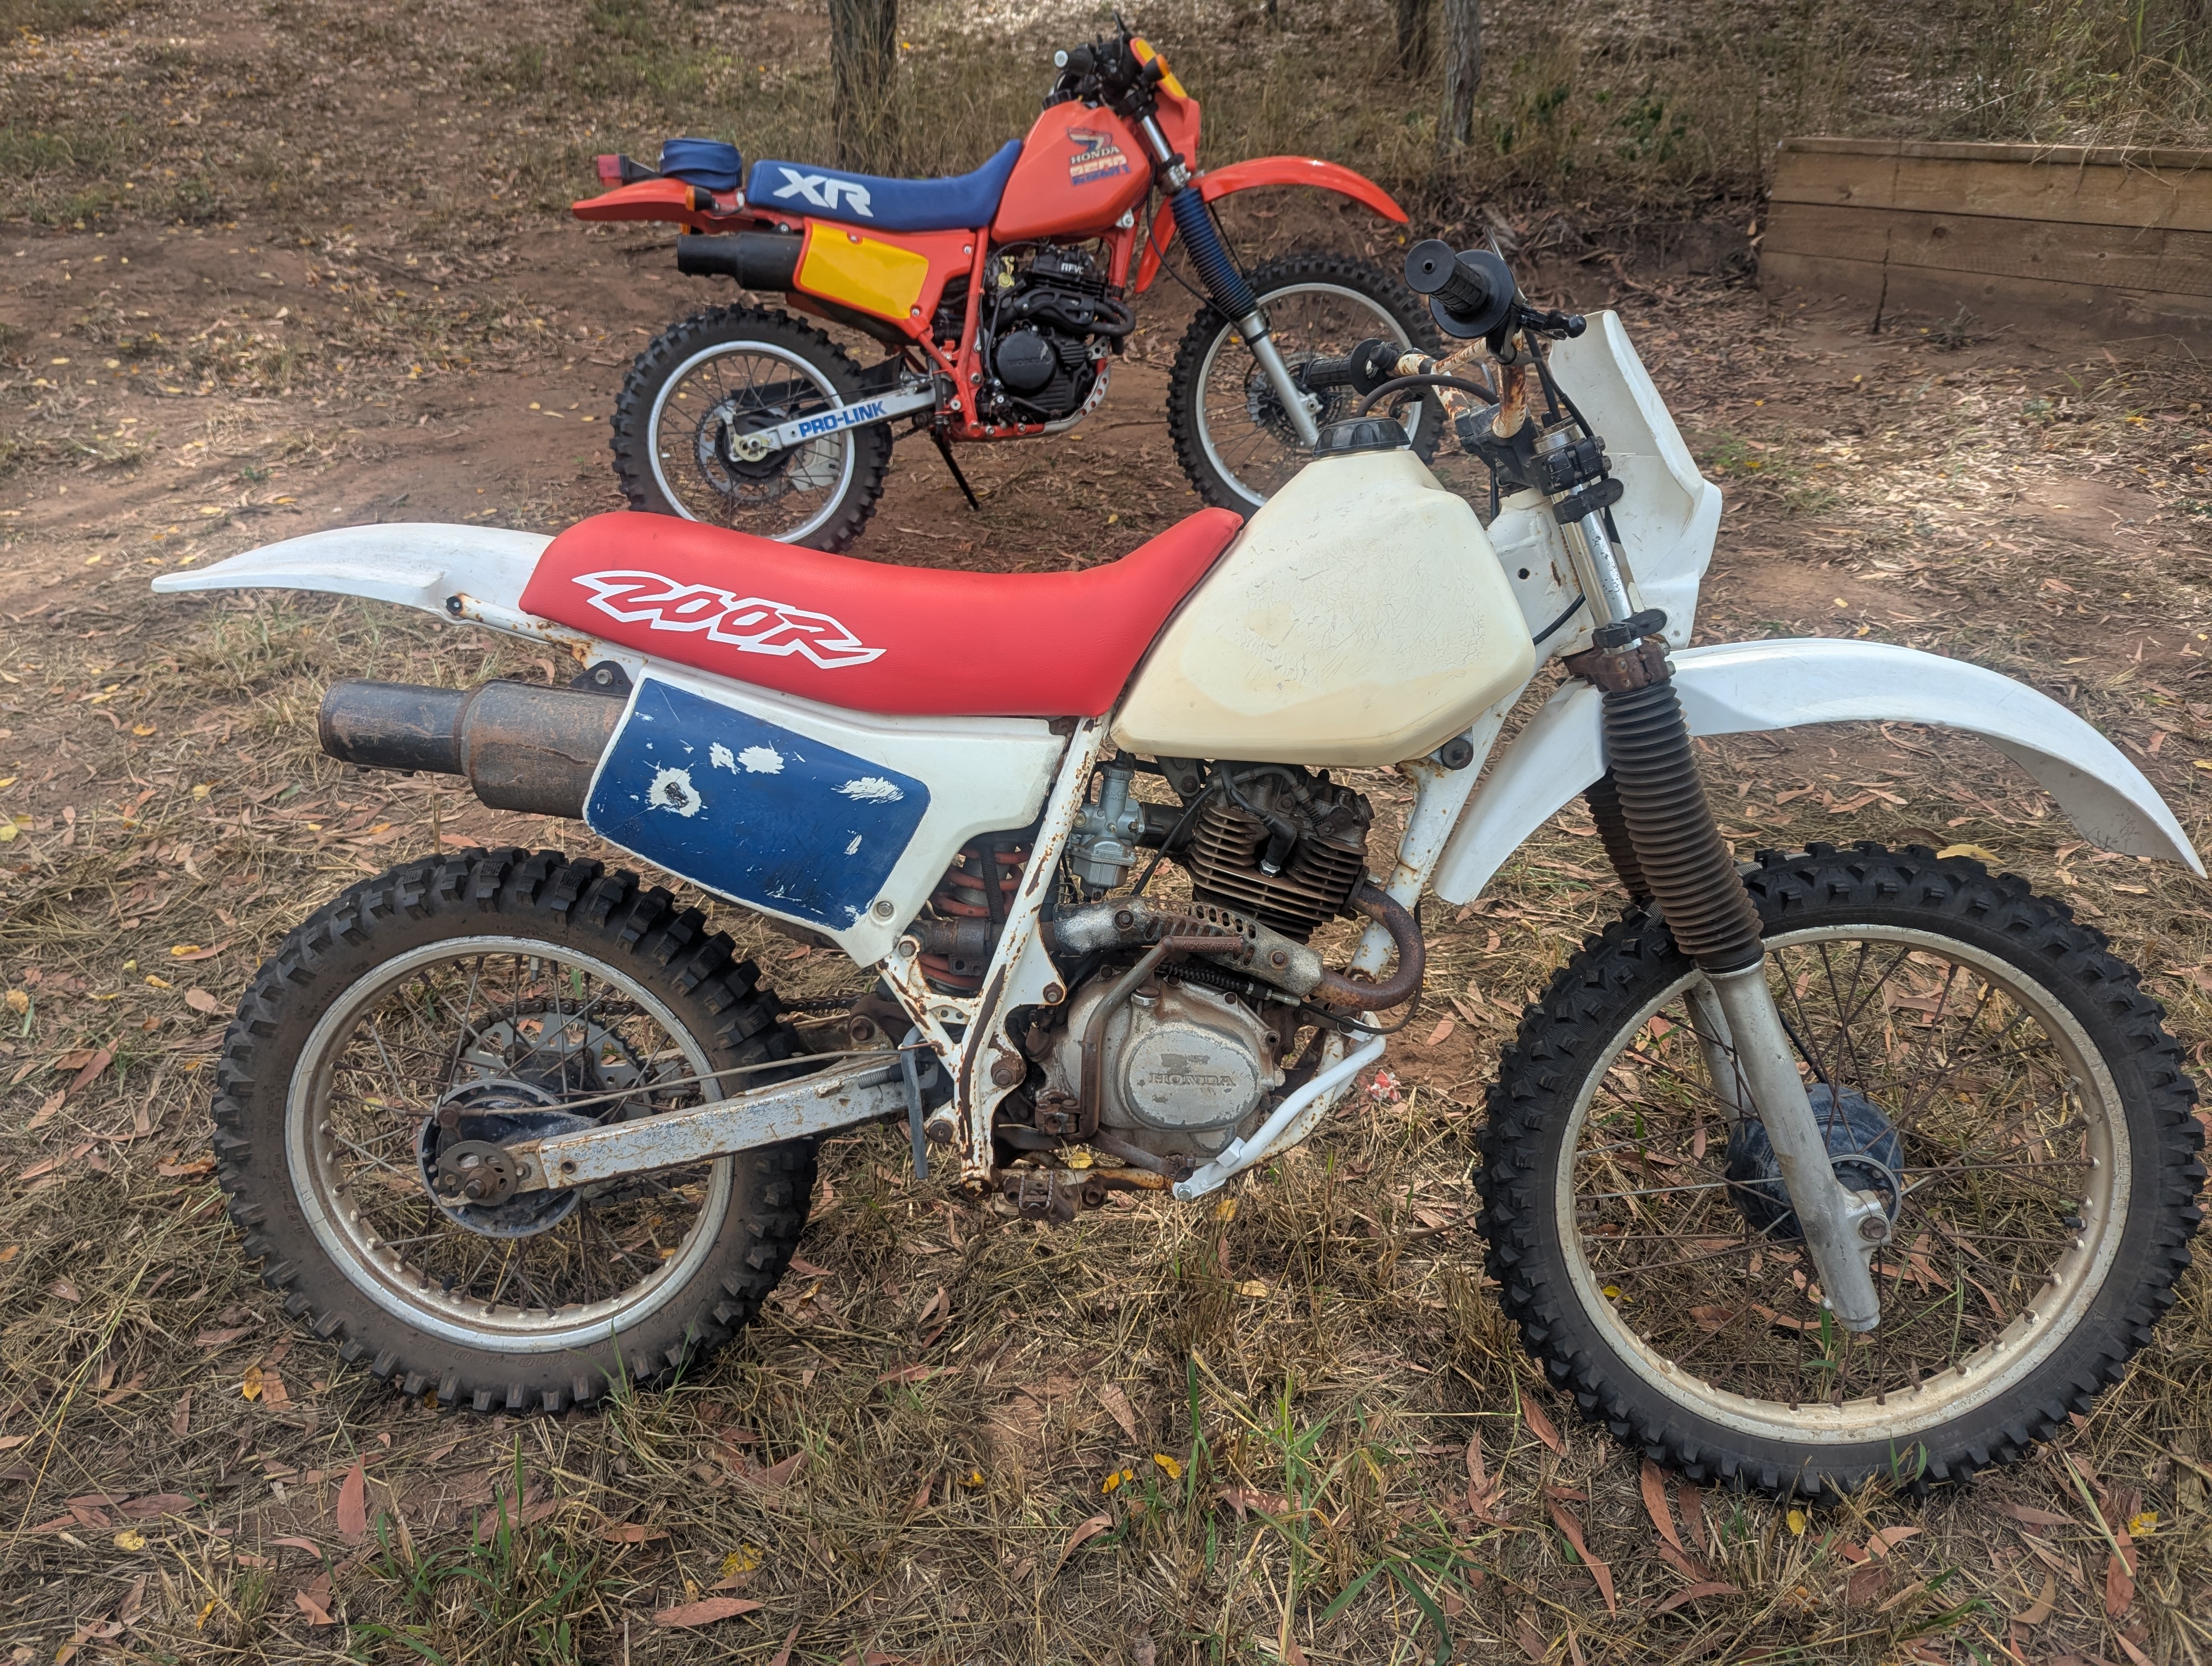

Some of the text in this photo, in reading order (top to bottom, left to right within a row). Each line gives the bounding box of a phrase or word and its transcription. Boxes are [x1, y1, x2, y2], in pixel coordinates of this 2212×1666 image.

[1070, 146, 1121, 164] HONDA
[773, 166, 874, 217] XR
[1061, 262, 1084, 275] RFVC
[798, 400, 888, 438] PRO-LINK
[571, 569, 887, 669] 200R
[1149, 1073, 1236, 1087] HONDA
